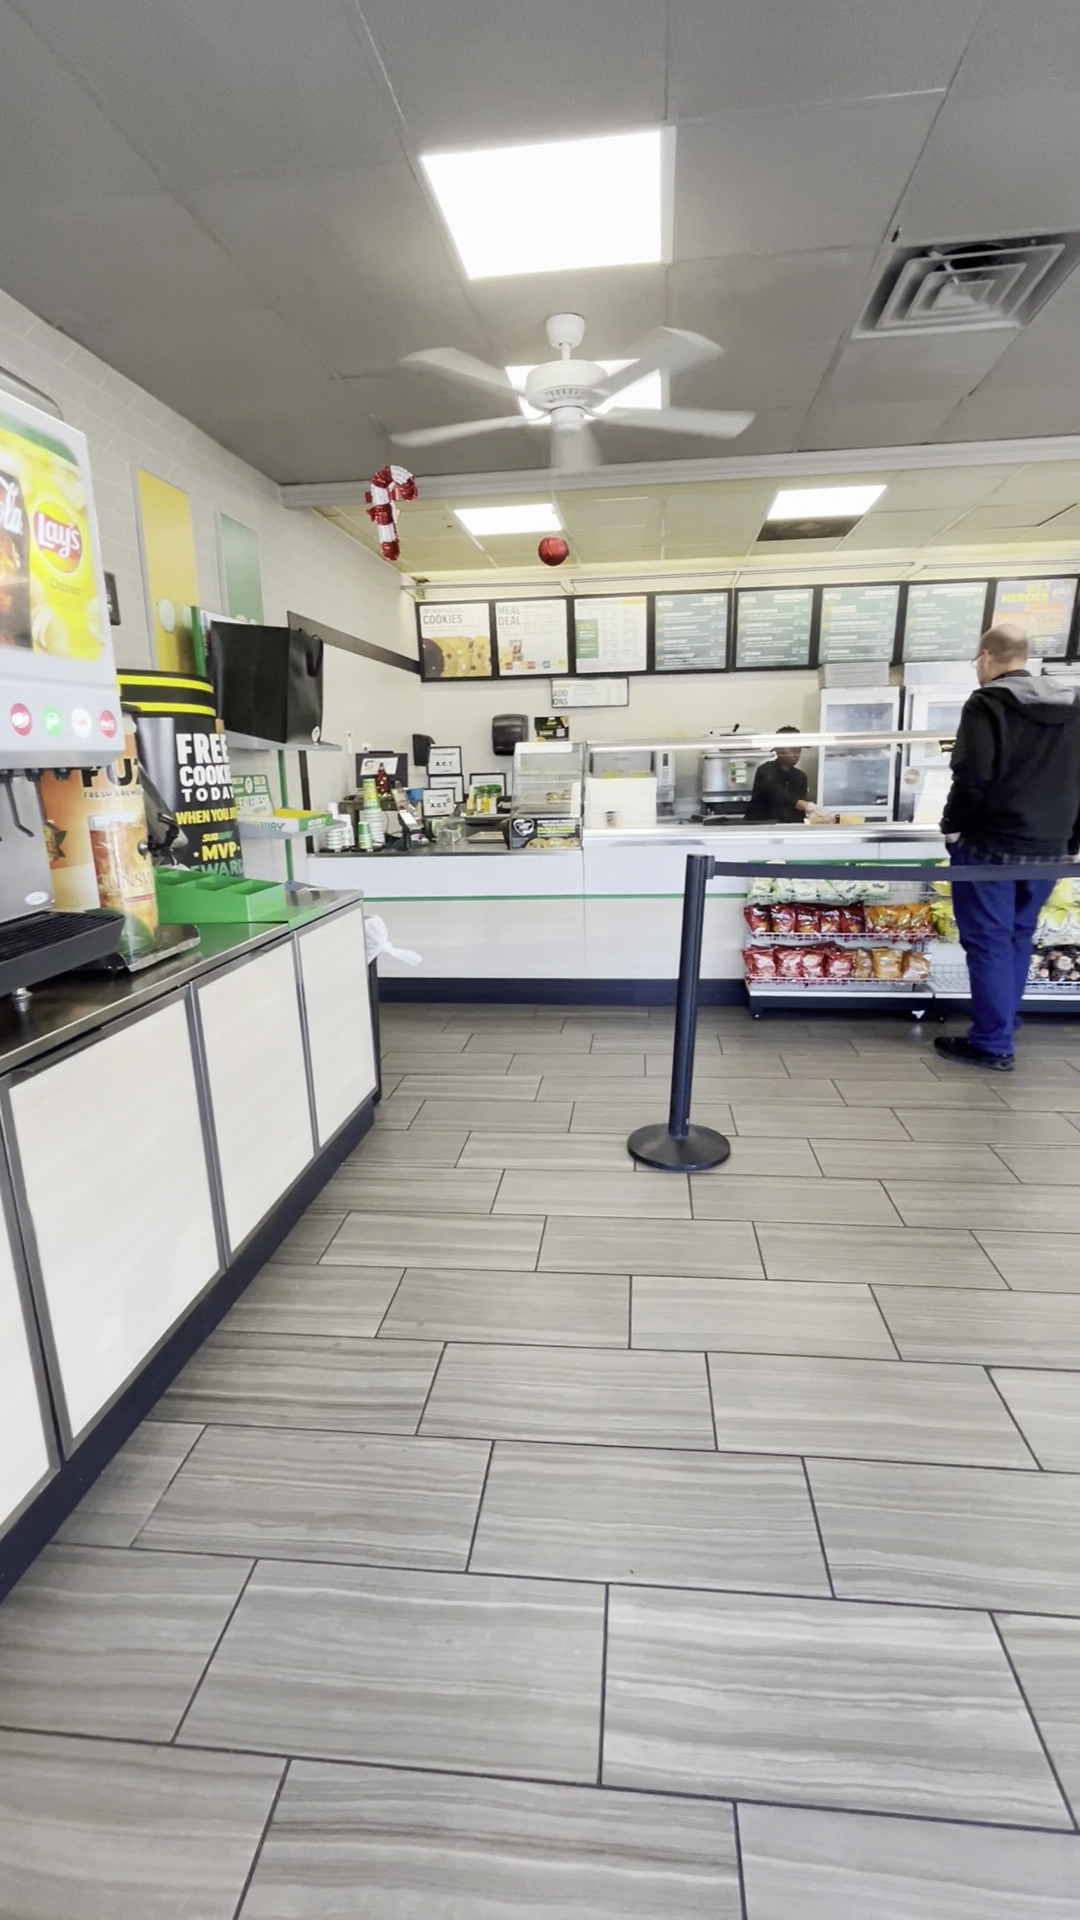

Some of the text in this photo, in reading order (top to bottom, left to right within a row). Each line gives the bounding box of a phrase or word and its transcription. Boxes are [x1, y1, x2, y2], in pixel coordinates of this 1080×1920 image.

[38, 512, 80, 558] Lay's
[498, 606, 521, 615] MEAL
[423, 614, 463, 625] COOKIES
[498, 615, 521, 626] DEAL
[175, 810, 211, 825] WHEN
[201, 841, 237, 862] MVP
